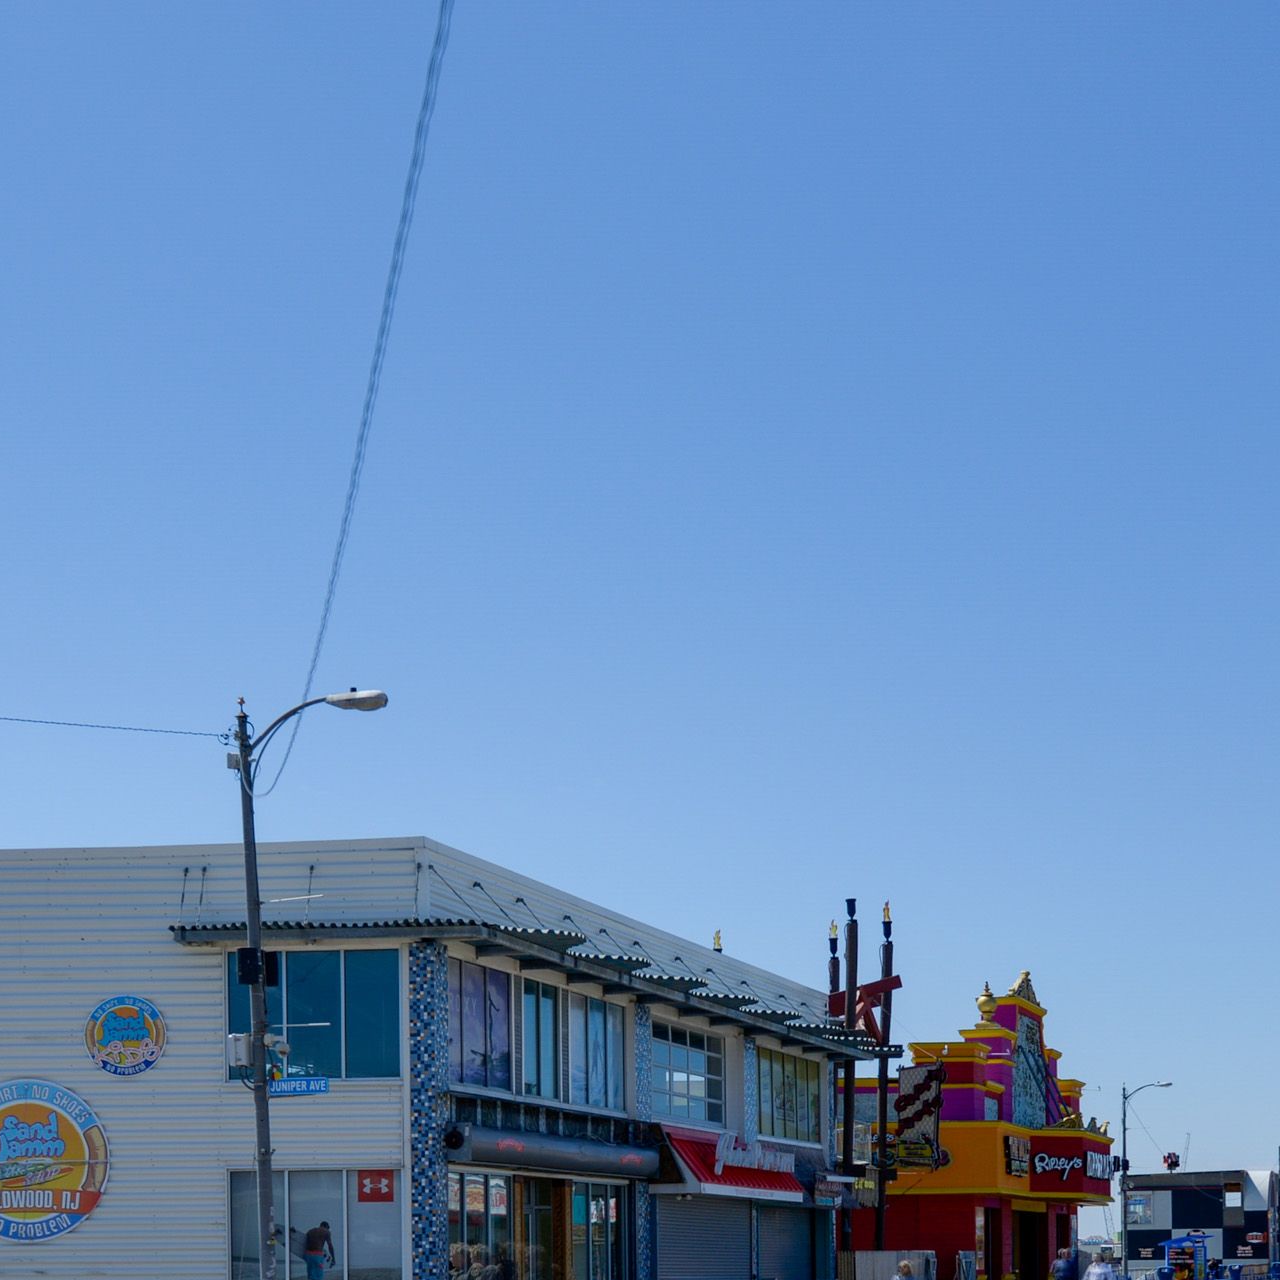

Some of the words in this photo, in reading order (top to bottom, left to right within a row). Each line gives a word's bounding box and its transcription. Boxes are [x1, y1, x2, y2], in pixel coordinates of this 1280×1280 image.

[270, 1080, 308, 1092] JUNIPER
[309, 1080, 326, 1091] AVE
[31, 1085, 50, 1099] NO
[53, 1091, 89, 1123] SHOES
[1, 1111, 58, 1141] Sand
